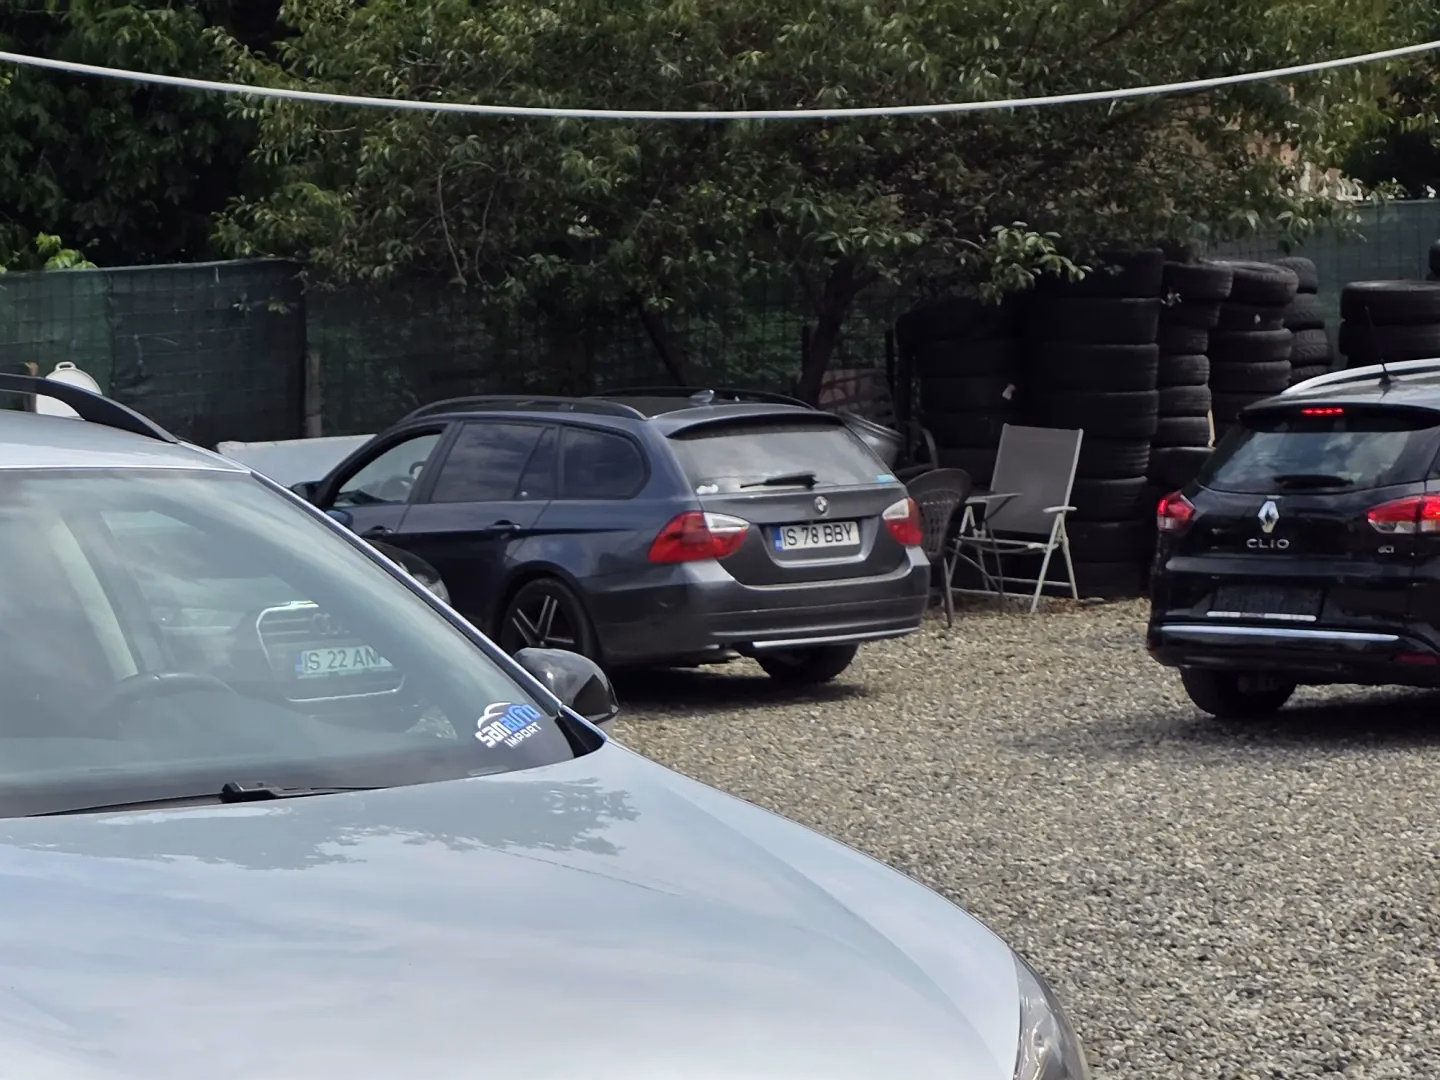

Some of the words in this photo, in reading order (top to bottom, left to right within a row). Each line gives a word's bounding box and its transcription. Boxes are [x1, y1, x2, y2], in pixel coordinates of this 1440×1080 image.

[783, 528, 797, 546] IS
[801, 527, 819, 545] 78
[823, 523, 853, 543] BBY
[1246, 538, 1289, 549] CLIO
[304, 652, 320, 671] IS
[327, 650, 348, 669] 22
[504, 722, 542, 748] IMPORT
